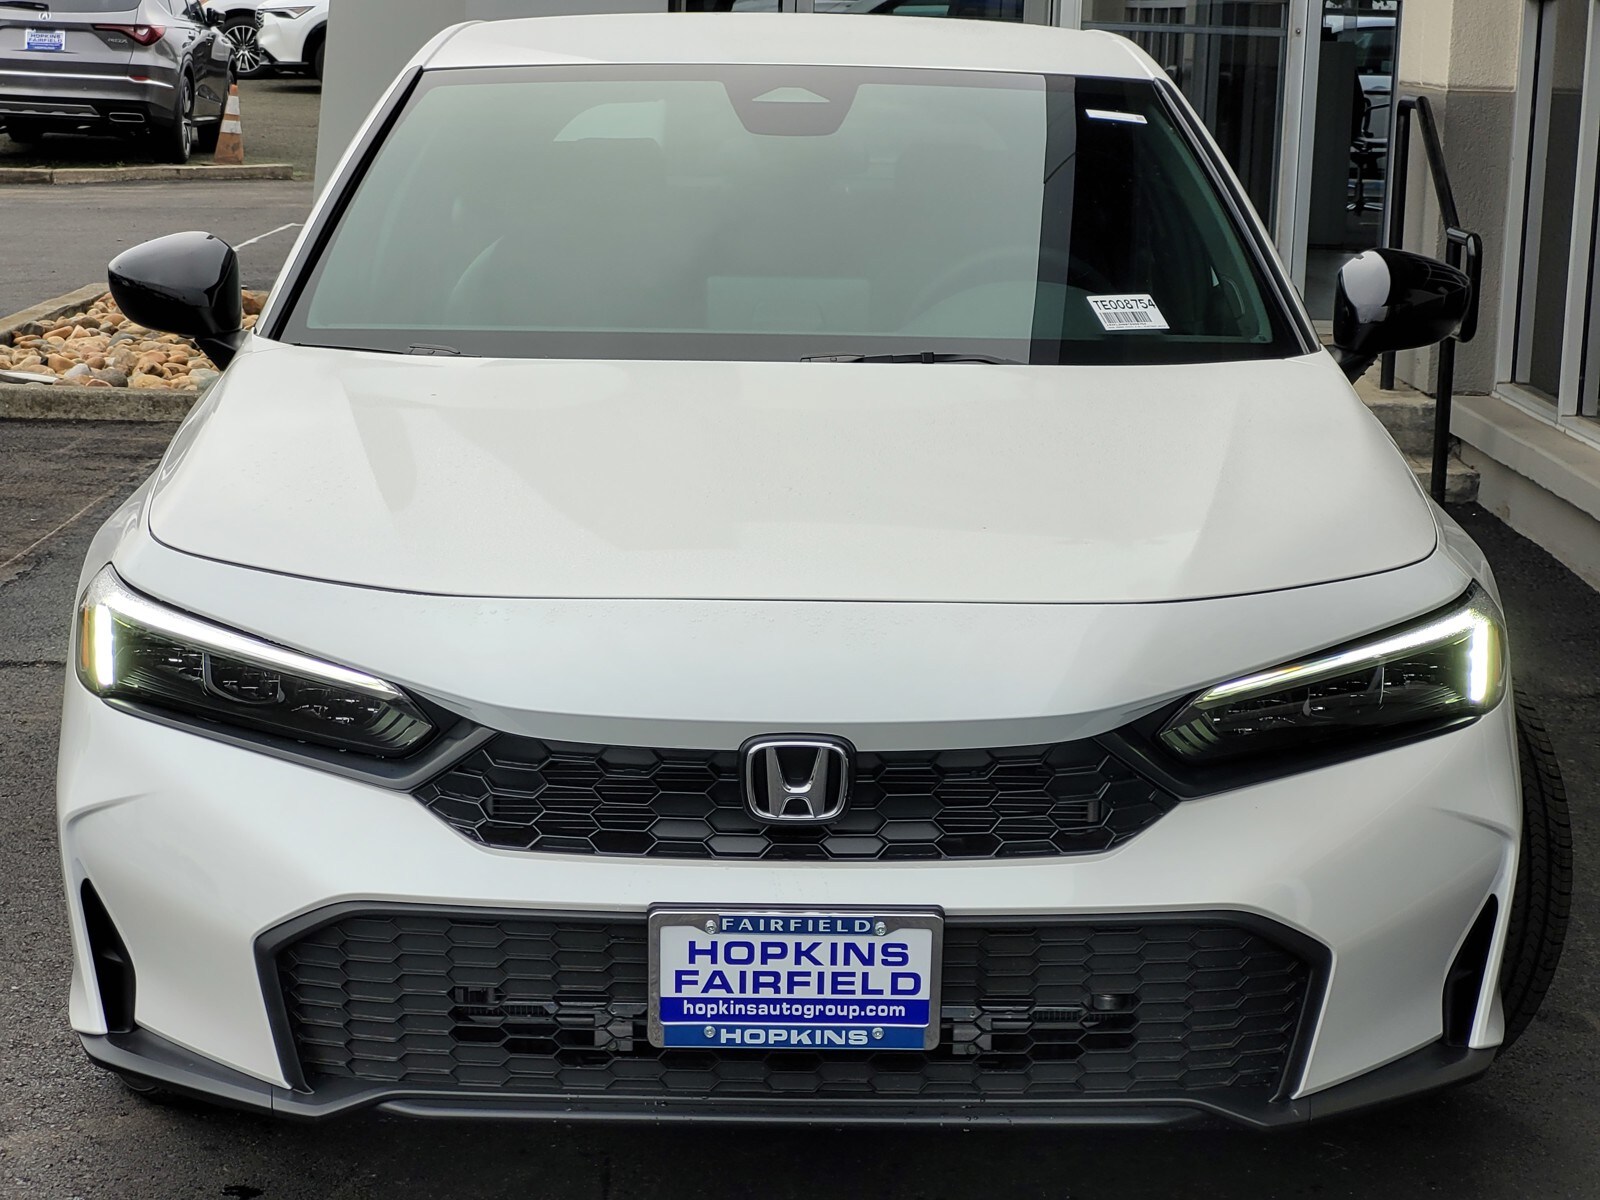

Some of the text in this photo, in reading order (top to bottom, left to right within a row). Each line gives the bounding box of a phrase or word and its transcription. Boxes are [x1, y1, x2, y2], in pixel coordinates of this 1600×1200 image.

[1093, 299, 1156, 310] TE008754
[722, 918, 871, 932] FAIRFIELD
[688, 940, 909, 967] HOPKINS
[674, 970, 922, 996] FAIRFIELD
[683, 1000, 906, 1019] hopkinsautogroup.com
[720, 1028, 868, 1045] HOPKINS
